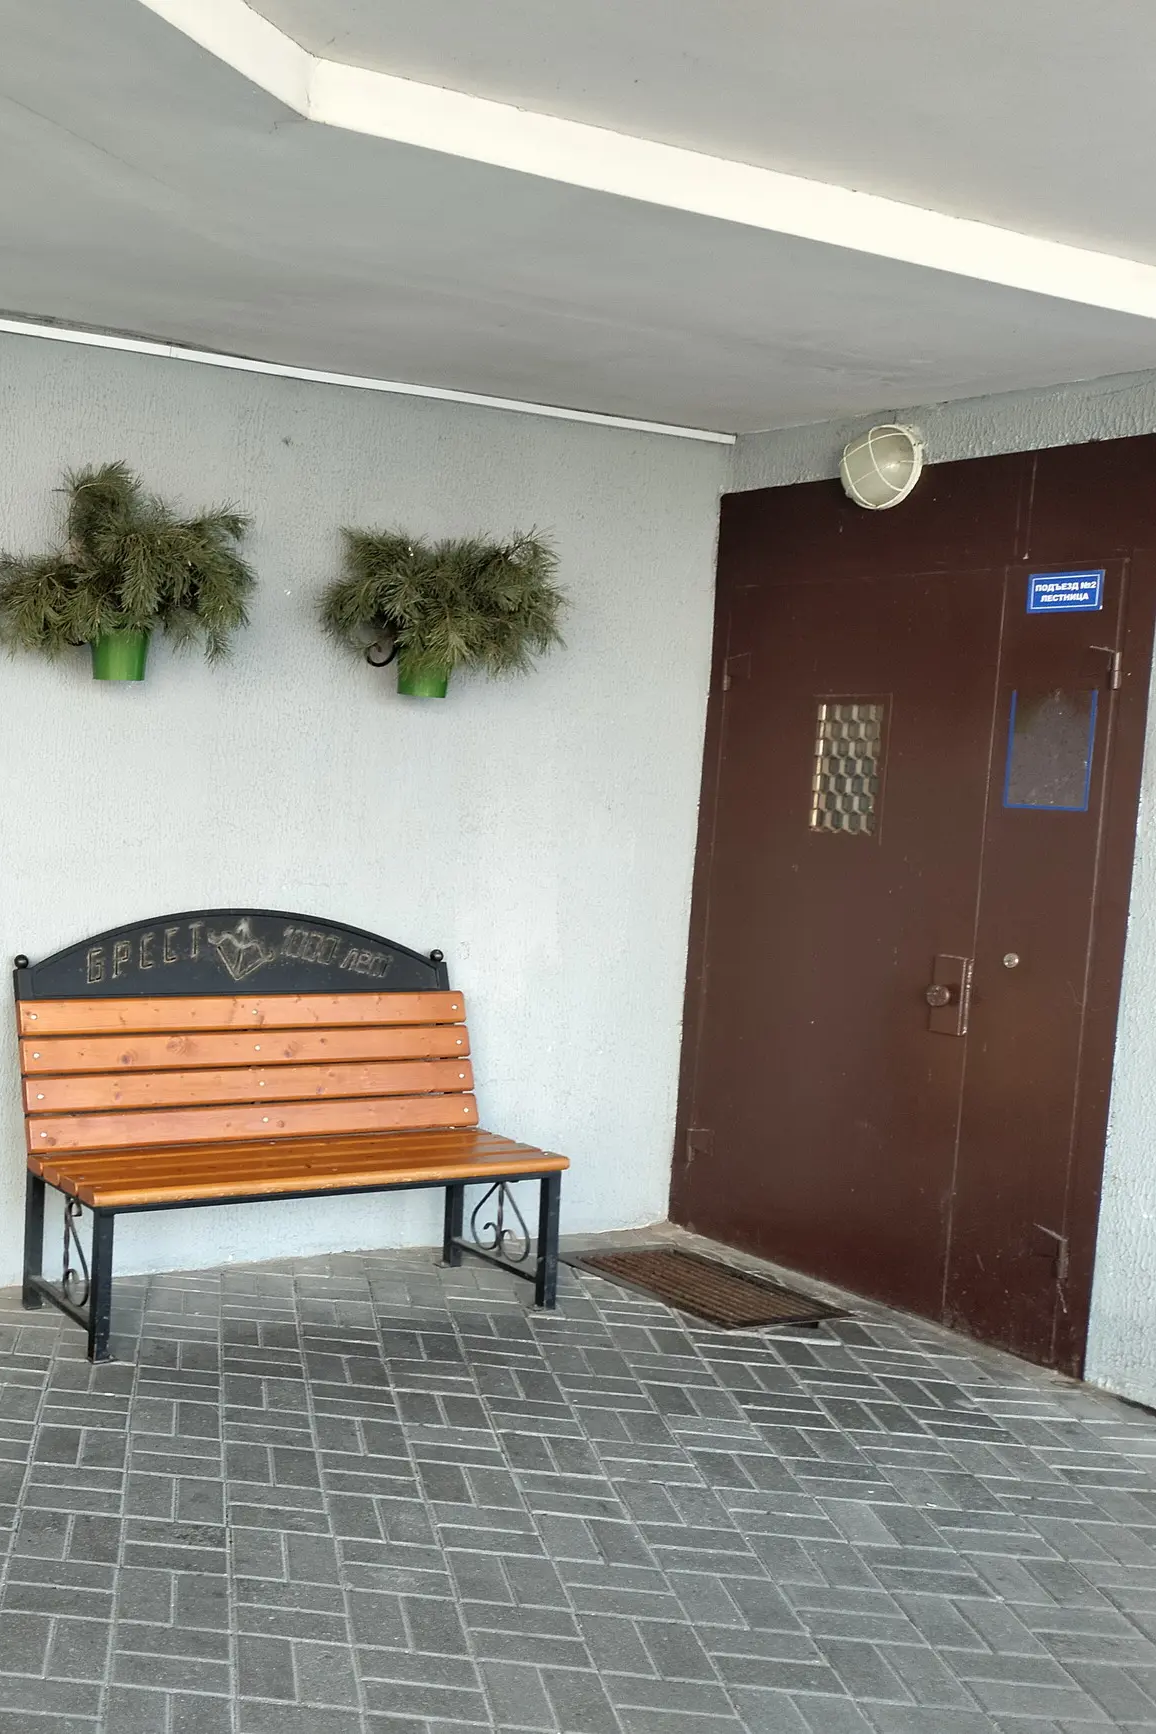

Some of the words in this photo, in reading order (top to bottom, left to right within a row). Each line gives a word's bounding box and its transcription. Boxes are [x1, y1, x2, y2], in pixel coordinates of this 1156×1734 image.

[1035, 582, 1079, 593] ПОДЪЕЗД
[1080, 581, 1097, 589] №2
[1040, 592, 1089, 603] ЛЕСТНИЦА
